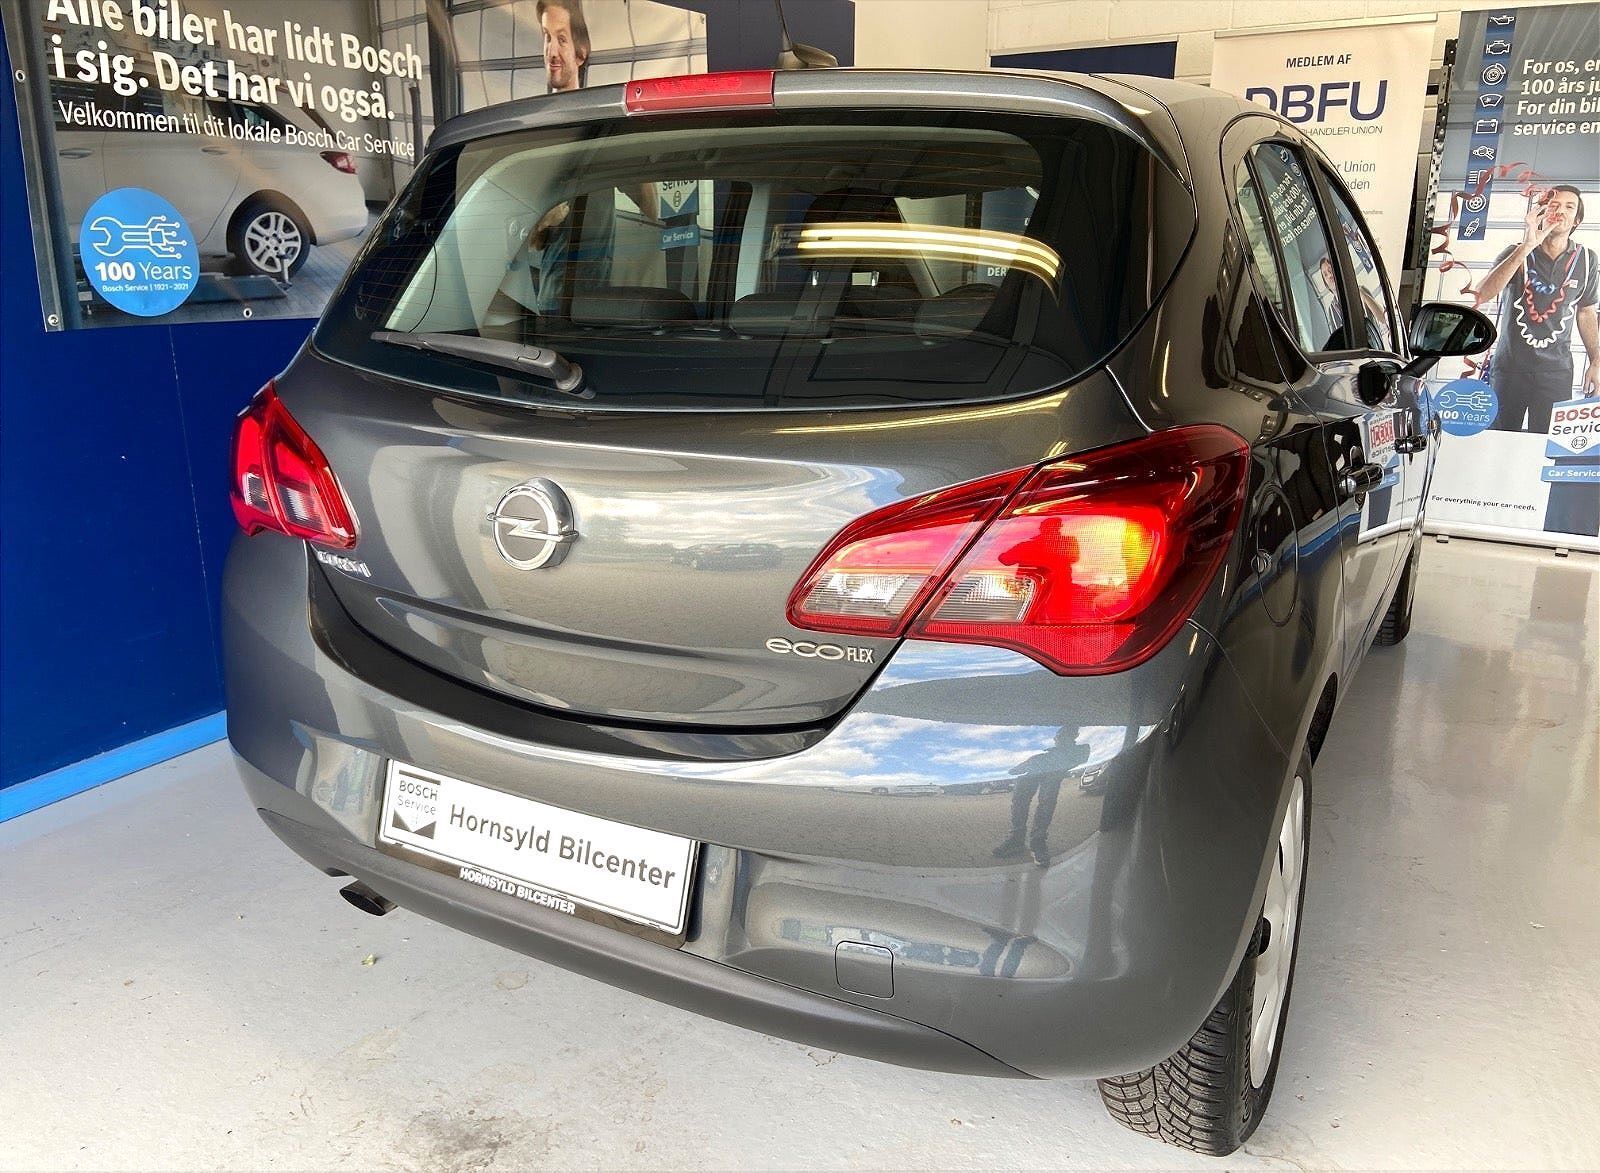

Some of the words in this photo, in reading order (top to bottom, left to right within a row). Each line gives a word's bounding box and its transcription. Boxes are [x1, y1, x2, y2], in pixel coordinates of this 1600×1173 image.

[46, 0, 124, 31] Alle
[132, 0, 217, 46] biler
[223, 10, 277, 56] har
[284, 21, 336, 67] lidt
[341, 33, 422, 80] Bosch
[1286, 55, 1334, 68] MEDLEM
[1337, 53, 1352, 65] AF
[1523, 59, 1552, 74] For
[1555, 60, 1579, 75] os,
[52, 34, 66, 79] i
[76, 40, 149, 96] sig.
[153, 51, 219, 97] Det
[227, 60, 280, 104] har
[287, 72, 315, 110] vi
[321, 81, 395, 122] også.
[1521, 79, 1554, 95] 100
[1558, 77, 1585, 93] års
[1245, 79, 1388, 123] DBFU
[1517, 101, 1545, 115] For
[1548, 98, 1575, 114] din
[58, 100, 182, 133] Velkommen
[182, 113, 200, 135] til
[203, 115, 225, 138] dit
[229, 118, 281, 144] lokale
[286, 124, 333, 149] Bosch
[336, 130, 360, 151] Car
[364, 133, 414, 156] Service
[1352, 125, 1383, 134] UNION
[1513, 119, 1576, 135] service
[1344, 161, 1376, 172] Union
[95, 262, 136, 281] 100
[139, 261, 192, 280] Years
[1439, 410, 1459, 419] 100
[1462, 411, 1490, 422] Years
[1445, 497, 1481, 506] everything
[400, 780, 438, 800] BOSCH
[398, 795, 436, 815] Service
[450, 804, 550, 853] Hornsyld
[559, 835, 675, 889] Bilcenter
[459, 867, 516, 895] HORNSYLD
[517, 884, 576, 915] BILCENTER
